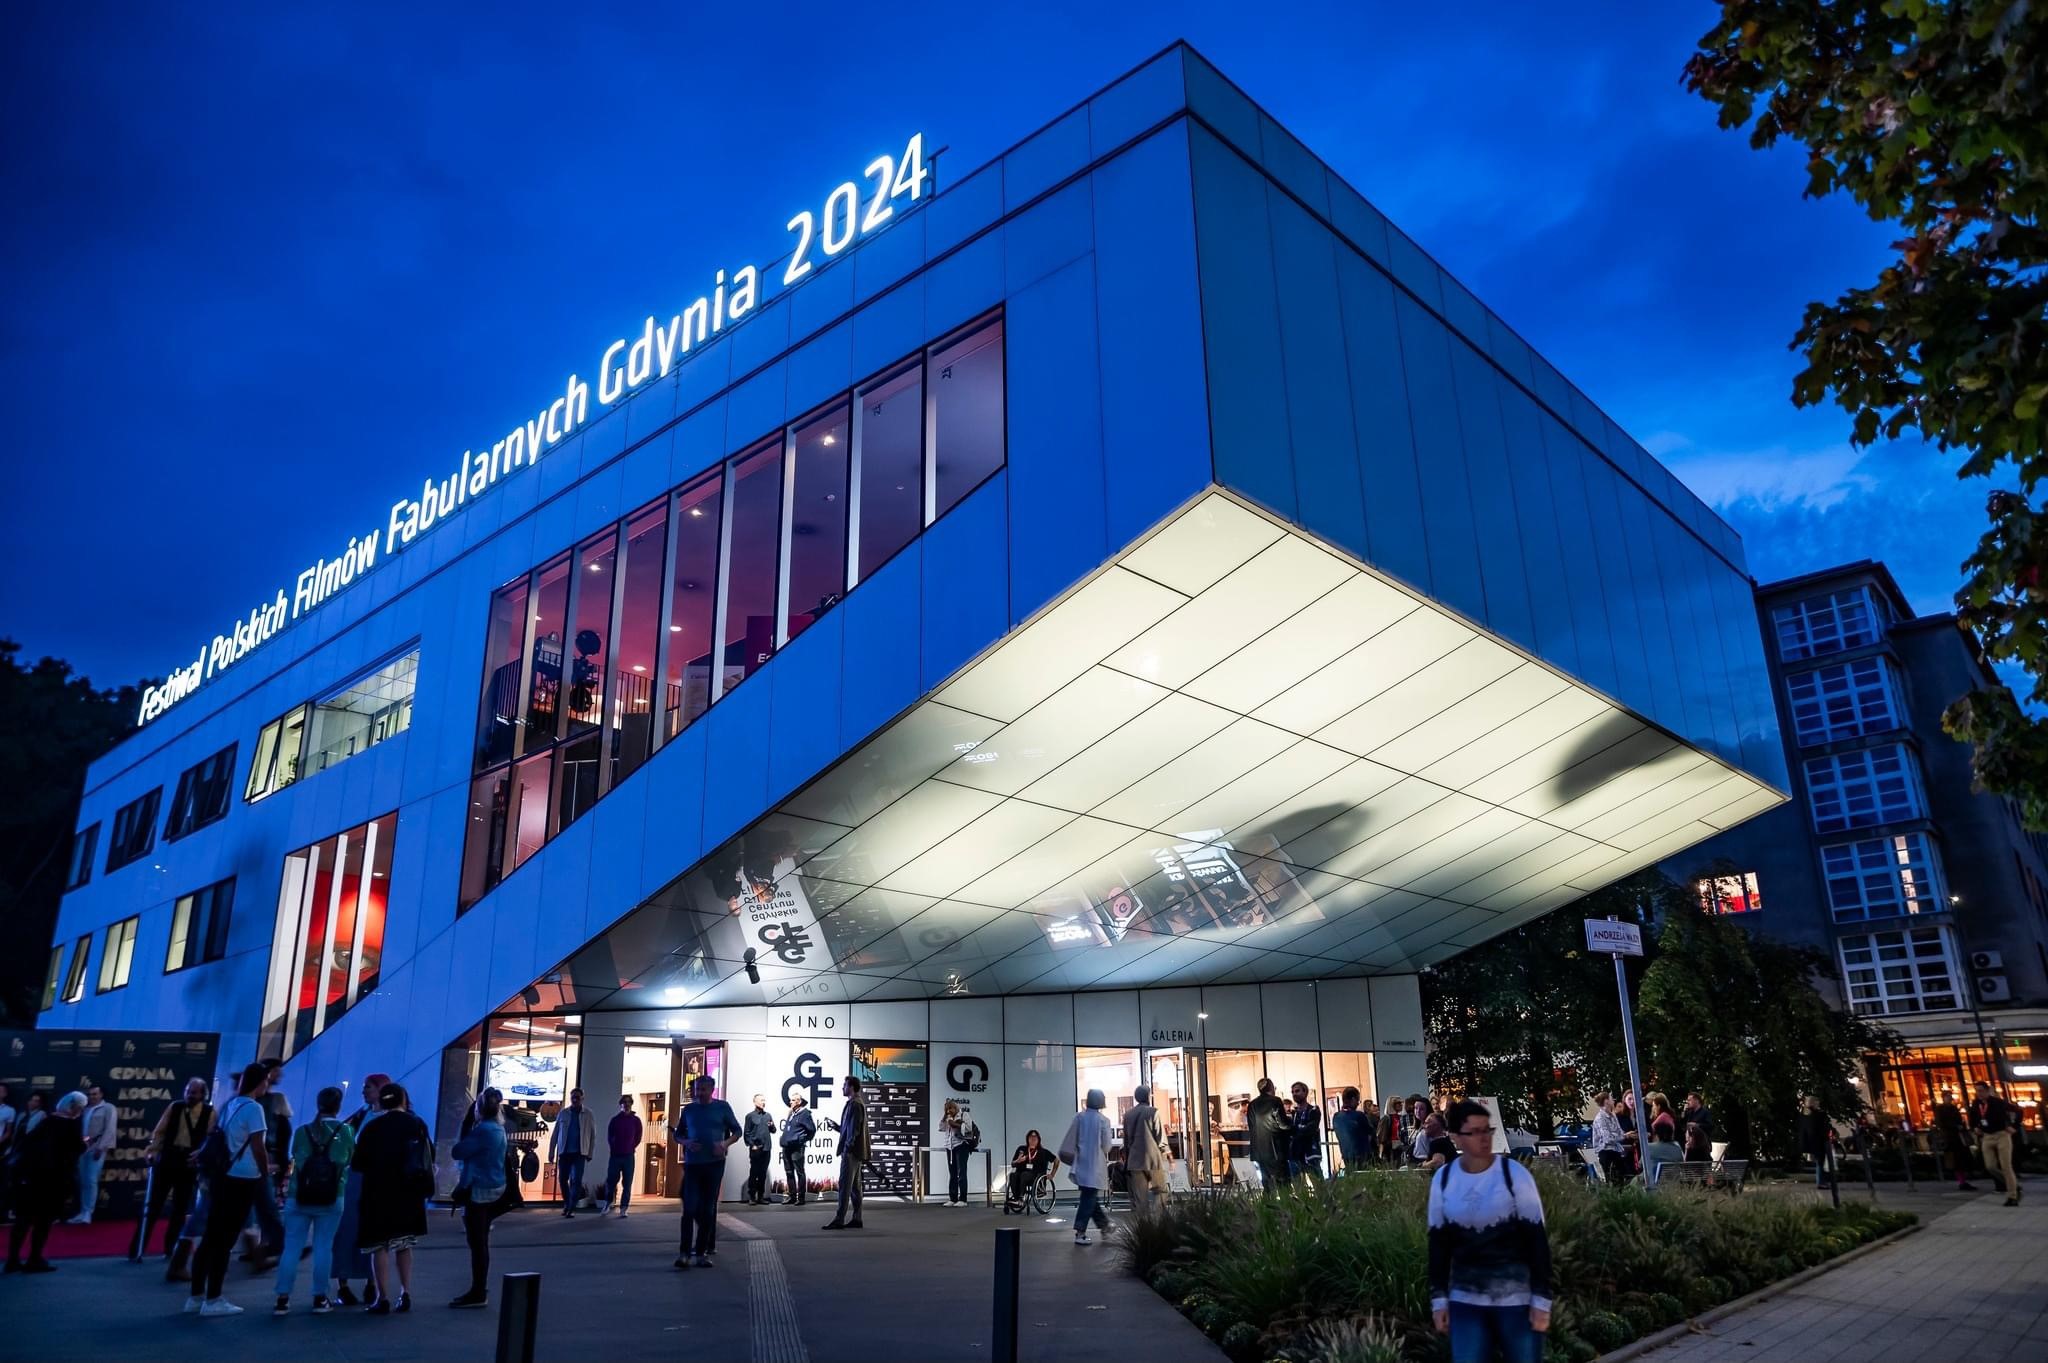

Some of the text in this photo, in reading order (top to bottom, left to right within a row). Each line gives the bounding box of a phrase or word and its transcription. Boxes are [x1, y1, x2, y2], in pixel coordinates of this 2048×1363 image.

[137, 132, 927, 727] Festiwal Polskich Filmów Fabularnych Gdynia 2024
[782, 1014, 835, 1029] KINO
[1152, 1029, 1194, 1042] GALERIA
